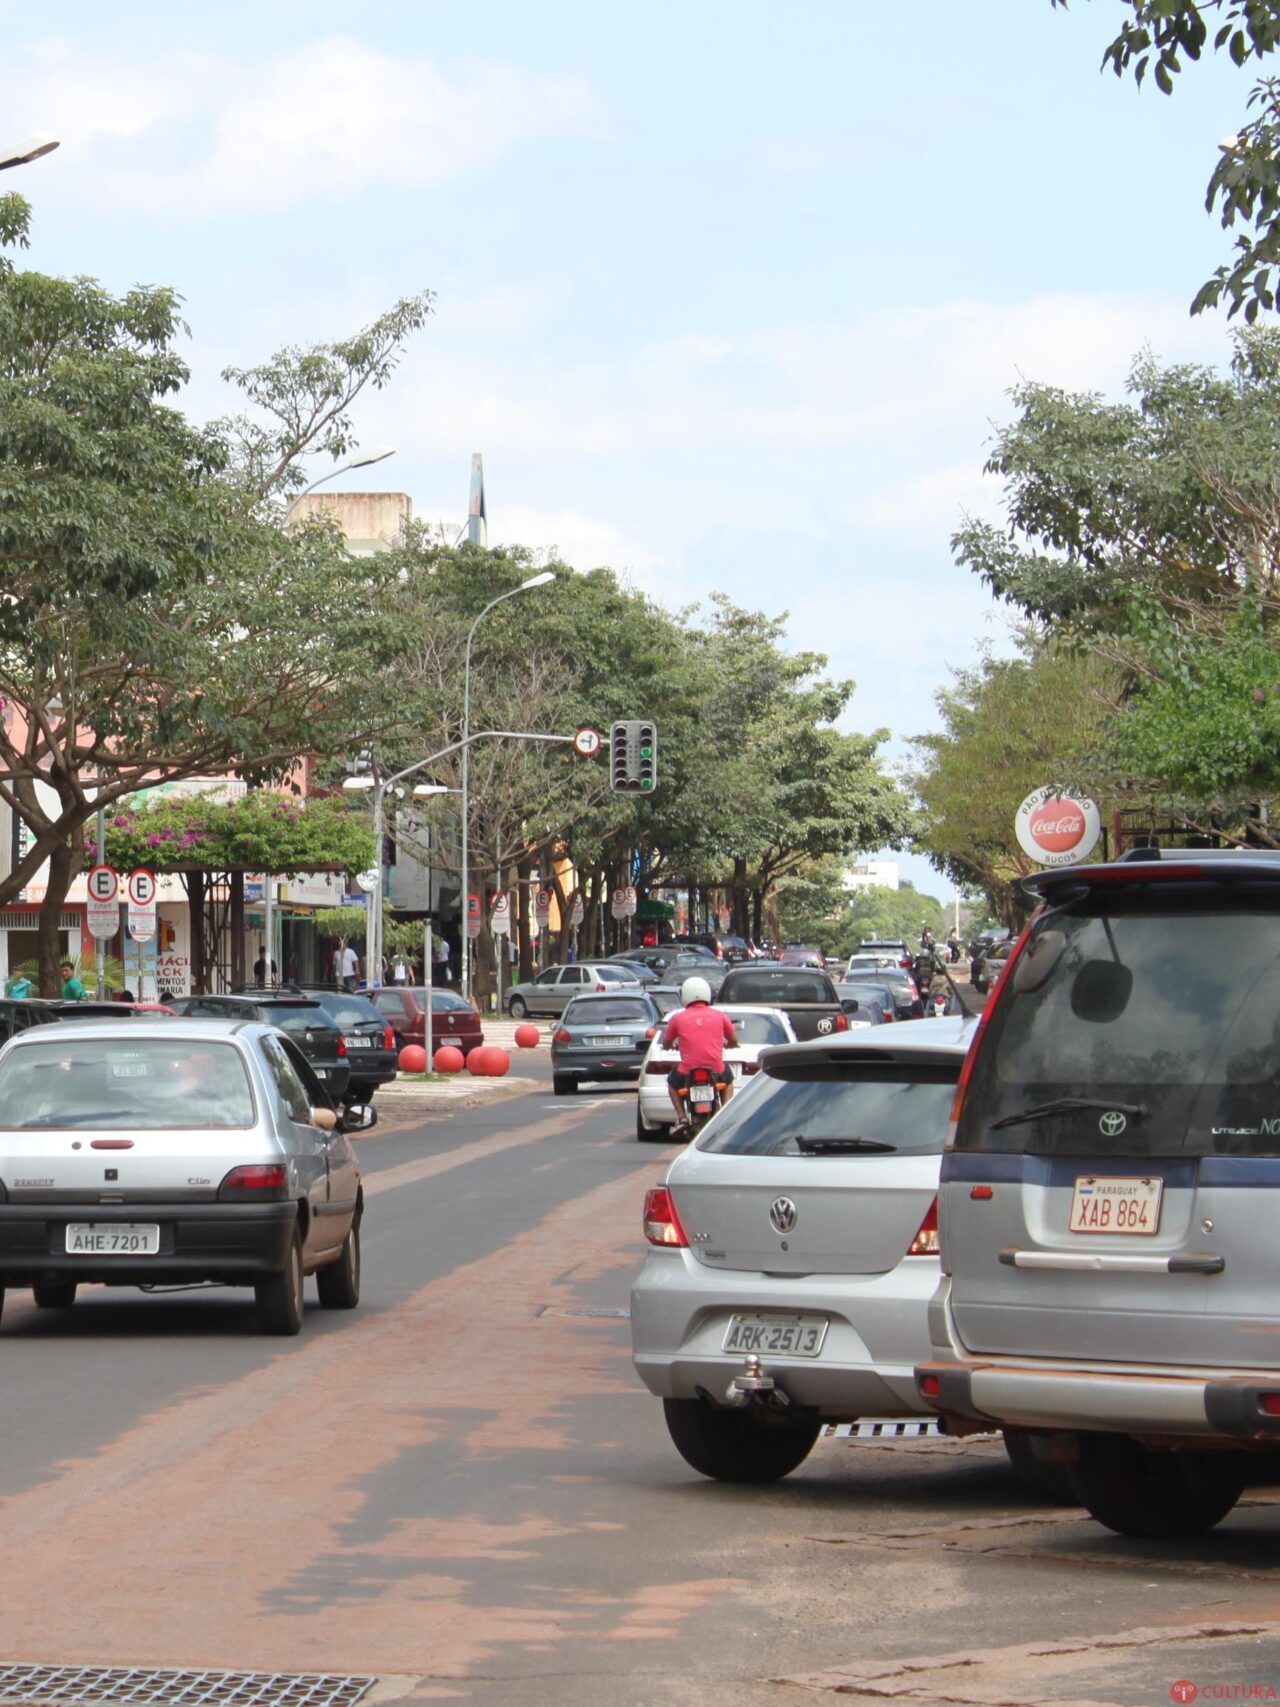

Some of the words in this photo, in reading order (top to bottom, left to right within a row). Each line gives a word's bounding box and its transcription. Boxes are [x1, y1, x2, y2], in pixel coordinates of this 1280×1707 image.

[1032, 816, 1081, 836] Coca-Cola
[1045, 852, 1077, 863] SUCOS
[97, 873, 109, 894] E
[137, 877, 147, 898] E
[187, 1176, 211, 1186] Clio
[1096, 1186, 1138, 1196] PARAGUAY
[1079, 1199, 1112, 1227] XAB
[1117, 1199, 1148, 1228] 864
